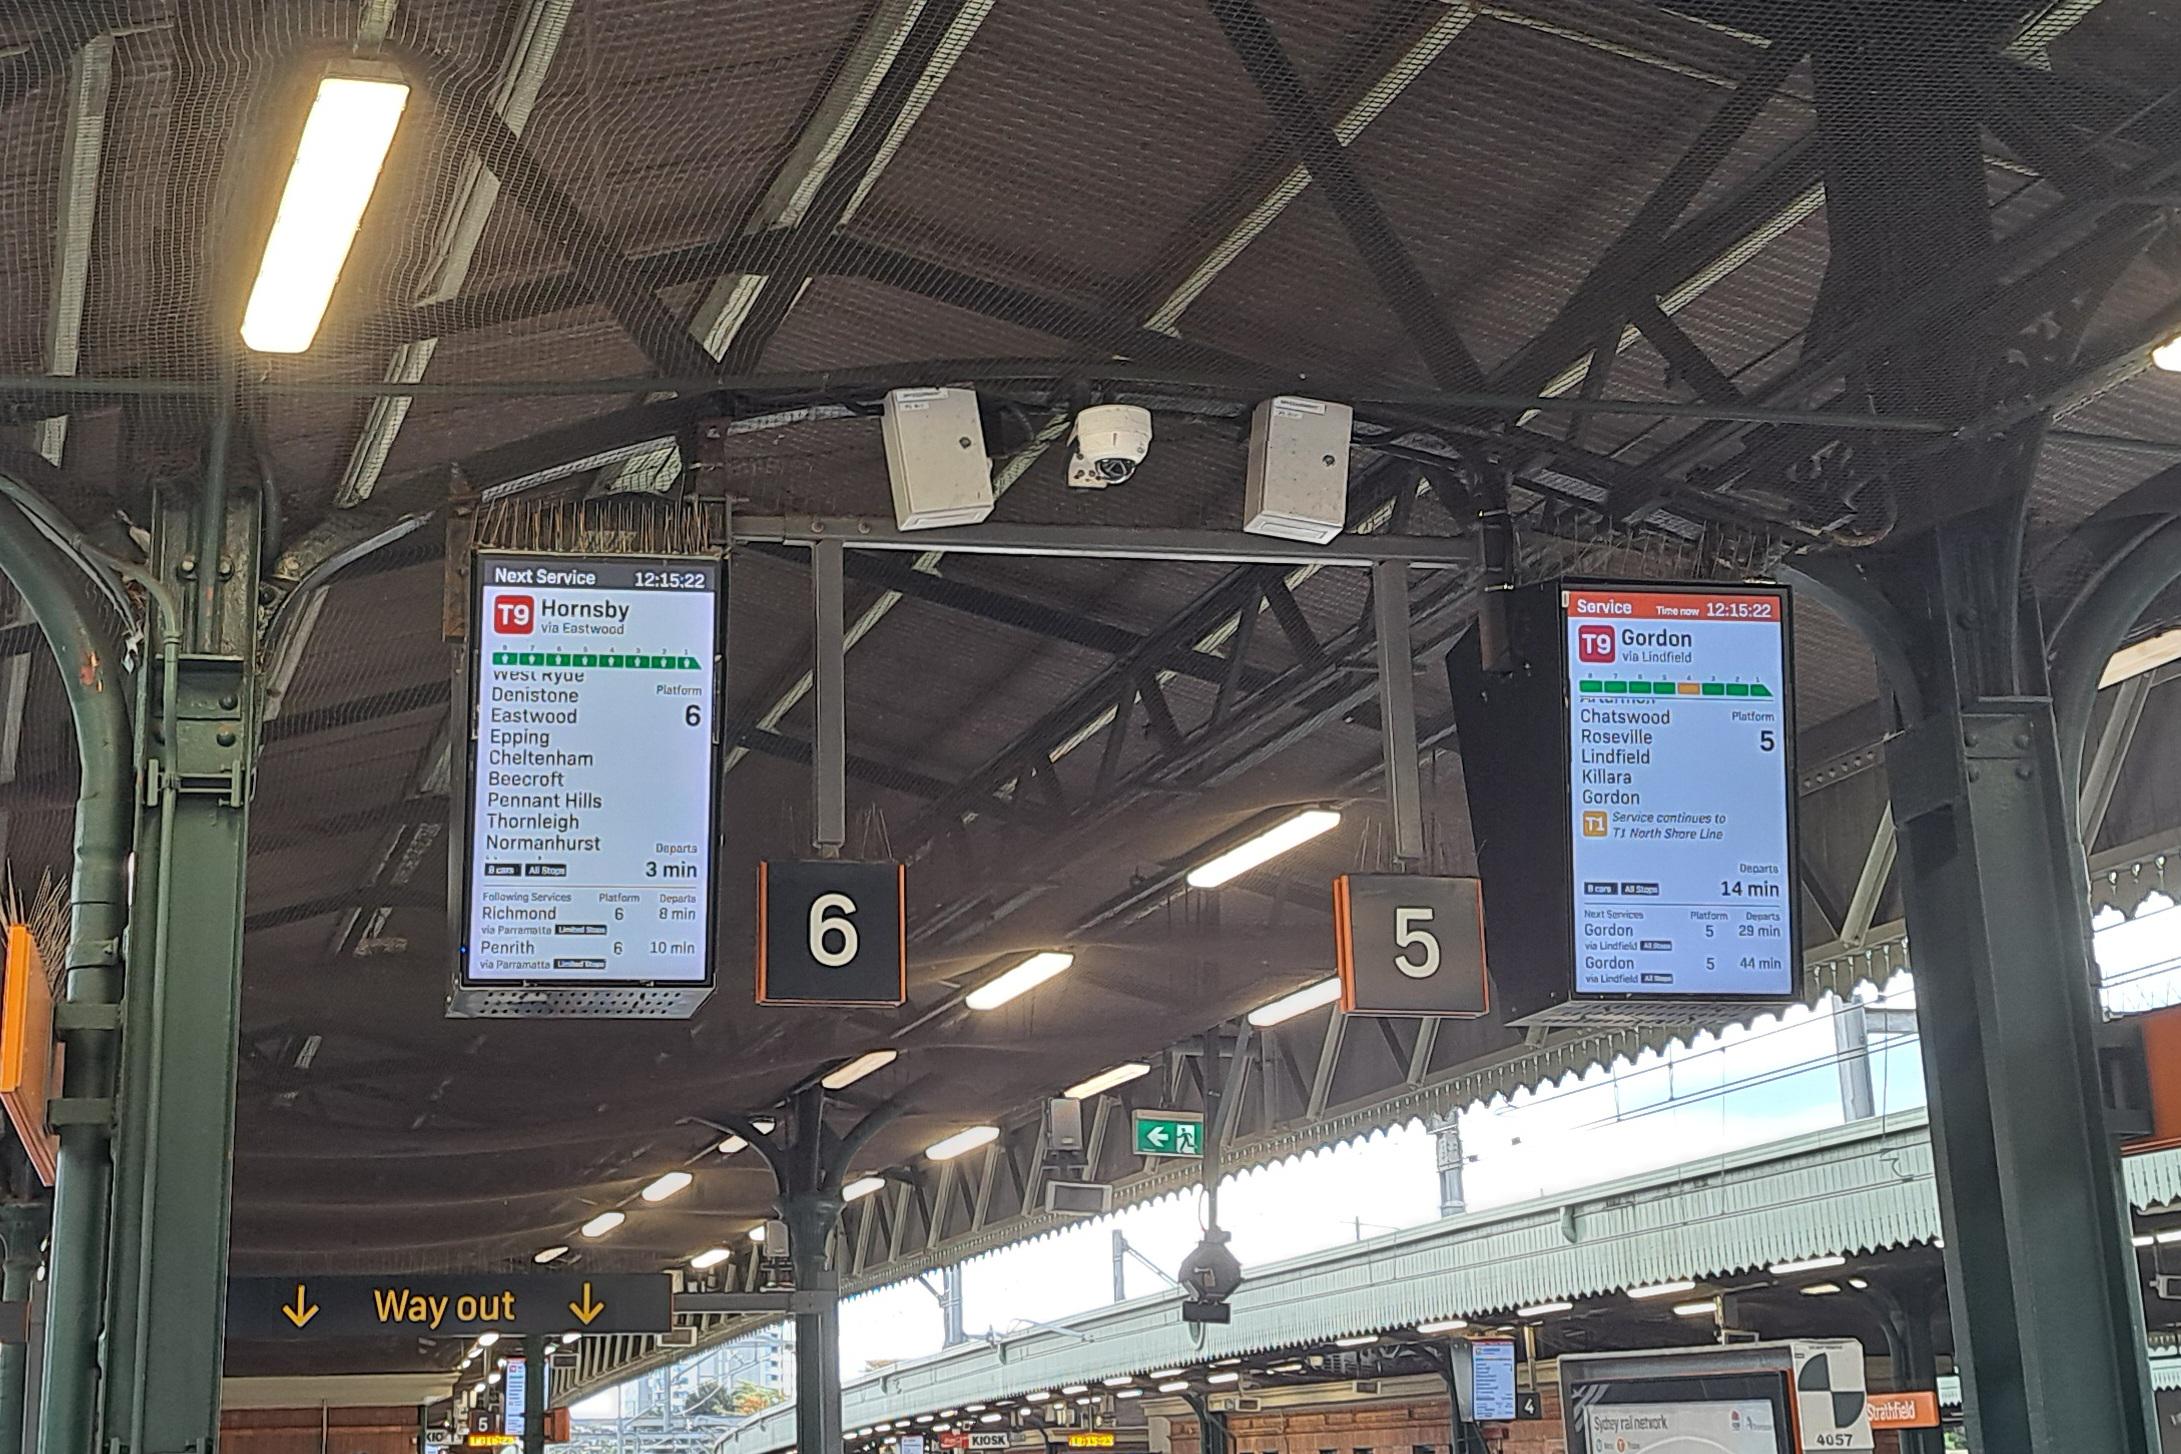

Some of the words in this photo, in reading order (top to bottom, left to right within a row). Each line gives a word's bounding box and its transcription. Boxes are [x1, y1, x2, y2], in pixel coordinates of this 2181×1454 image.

[494, 567, 533, 584] Next
[536, 569, 597, 585] Service
[634, 571, 705, 588] 12:15:22
[542, 599, 630, 622] Hornsby
[1576, 599, 1632, 615] Service
[1656, 605, 1678, 616] Time
[1680, 607, 1700, 616] now
[1707, 602, 1772, 618] 12:15:22
[498, 604, 530, 626] T9
[541, 621, 560, 634] via
[563, 623, 625, 635] Eastwood
[1582, 634, 1612, 655] T9
[1622, 628, 1692, 647] Gordon
[1622, 651, 1639, 662] via
[1642, 651, 1692, 663] Lindfield
[491, 686, 579, 703] Denistone
[656, 684, 703, 696] Platform
[491, 707, 578, 724] Eastwood
[685, 705, 702, 727] 6
[1581, 708, 1670, 725] Chatswood
[1732, 711, 1775, 722] Platform
[491, 728, 550, 747] Epping
[1582, 729, 1653, 745] Roseville
[1760, 730, 1775, 752] 5
[489, 749, 594, 767] Cheltenham
[1582, 749, 1651, 765] Lindfield
[488, 770, 565, 787] Beecroft
[1583, 769, 1632, 785] Killara
[488, 792, 561, 808] Pennant
[565, 793, 603, 809] Hills
[1583, 789, 1640, 805] Gordon
[487, 812, 580, 832] Thornleigh
[1585, 816, 1605, 832] T1
[1612, 811, 1654, 823] Service
[1656, 812, 1712, 824] continues
[1714, 813, 1726, 824] to
[1614, 828, 1626, 839] T1
[1629, 828, 1662, 839] North
[1664, 828, 1697, 840] Shore
[1699, 828, 1723, 840] Line
[486, 834, 601, 851] Normanhurst
[656, 843, 698, 856] Departs
[528, 865, 540, 875] All
[645, 861, 657, 877] 3
[663, 862, 697, 878] min
[1739, 863, 1779, 875] Departs
[1720, 881, 1742, 897] 14
[1747, 881, 1780, 897] min
[482, 892, 529, 903] Following
[531, 892, 572, 902] Services
[599, 893, 640, 903] Platform
[659, 894, 697, 904] Departs
[481, 905, 557, 920] Richmond
[614, 907, 624, 921] 6
[659, 908, 668, 920] 8
[671, 908, 696, 920] min
[1584, 910, 1605, 920] Next
[1607, 910, 1644, 920] Services
[1690, 911, 1729, 921] Platform
[1745, 912, 1780, 922] Departs
[481, 925, 495, 935] via
[498, 925, 552, 935] Parramatta
[808, 893, 860, 968] 6
[1584, 923, 1634, 937] Gordon
[1705, 925, 1714, 938] 5
[1738, 925, 1754, 937] 29
[1758, 925, 1781, 937] min
[480, 940, 535, 955] Penrith
[613, 942, 623, 955] 6
[650, 941, 668, 954] 10
[671, 941, 695, 955] min
[1393, 907, 1443, 978] 5
[1585, 942, 1598, 950] via
[1600, 942, 1638, 951] Lindfield
[480, 960, 494, 969] via
[496, 959, 551, 970] Parramatta
[1585, 955, 1635, 970] Gordon
[1706, 957, 1715, 970] 5
[1739, 957, 1756, 970] 44
[1759, 957, 1782, 970] min
[1585, 975, 1599, 983] via
[1600, 974, 1639, 983] Lindfield
[374, 1289, 448, 1330] Way
[457, 1290, 515, 1322] out
[1524, 1398, 1535, 1415] 4
[1867, 1401, 1916, 1421] Strathfield
[478, 1417, 488, 1432] 5
[1634, 1414, 1668, 1431] network
[972, 1435, 1005, 1446] KIOSK
[1816, 1433, 1853, 1446] 4057
